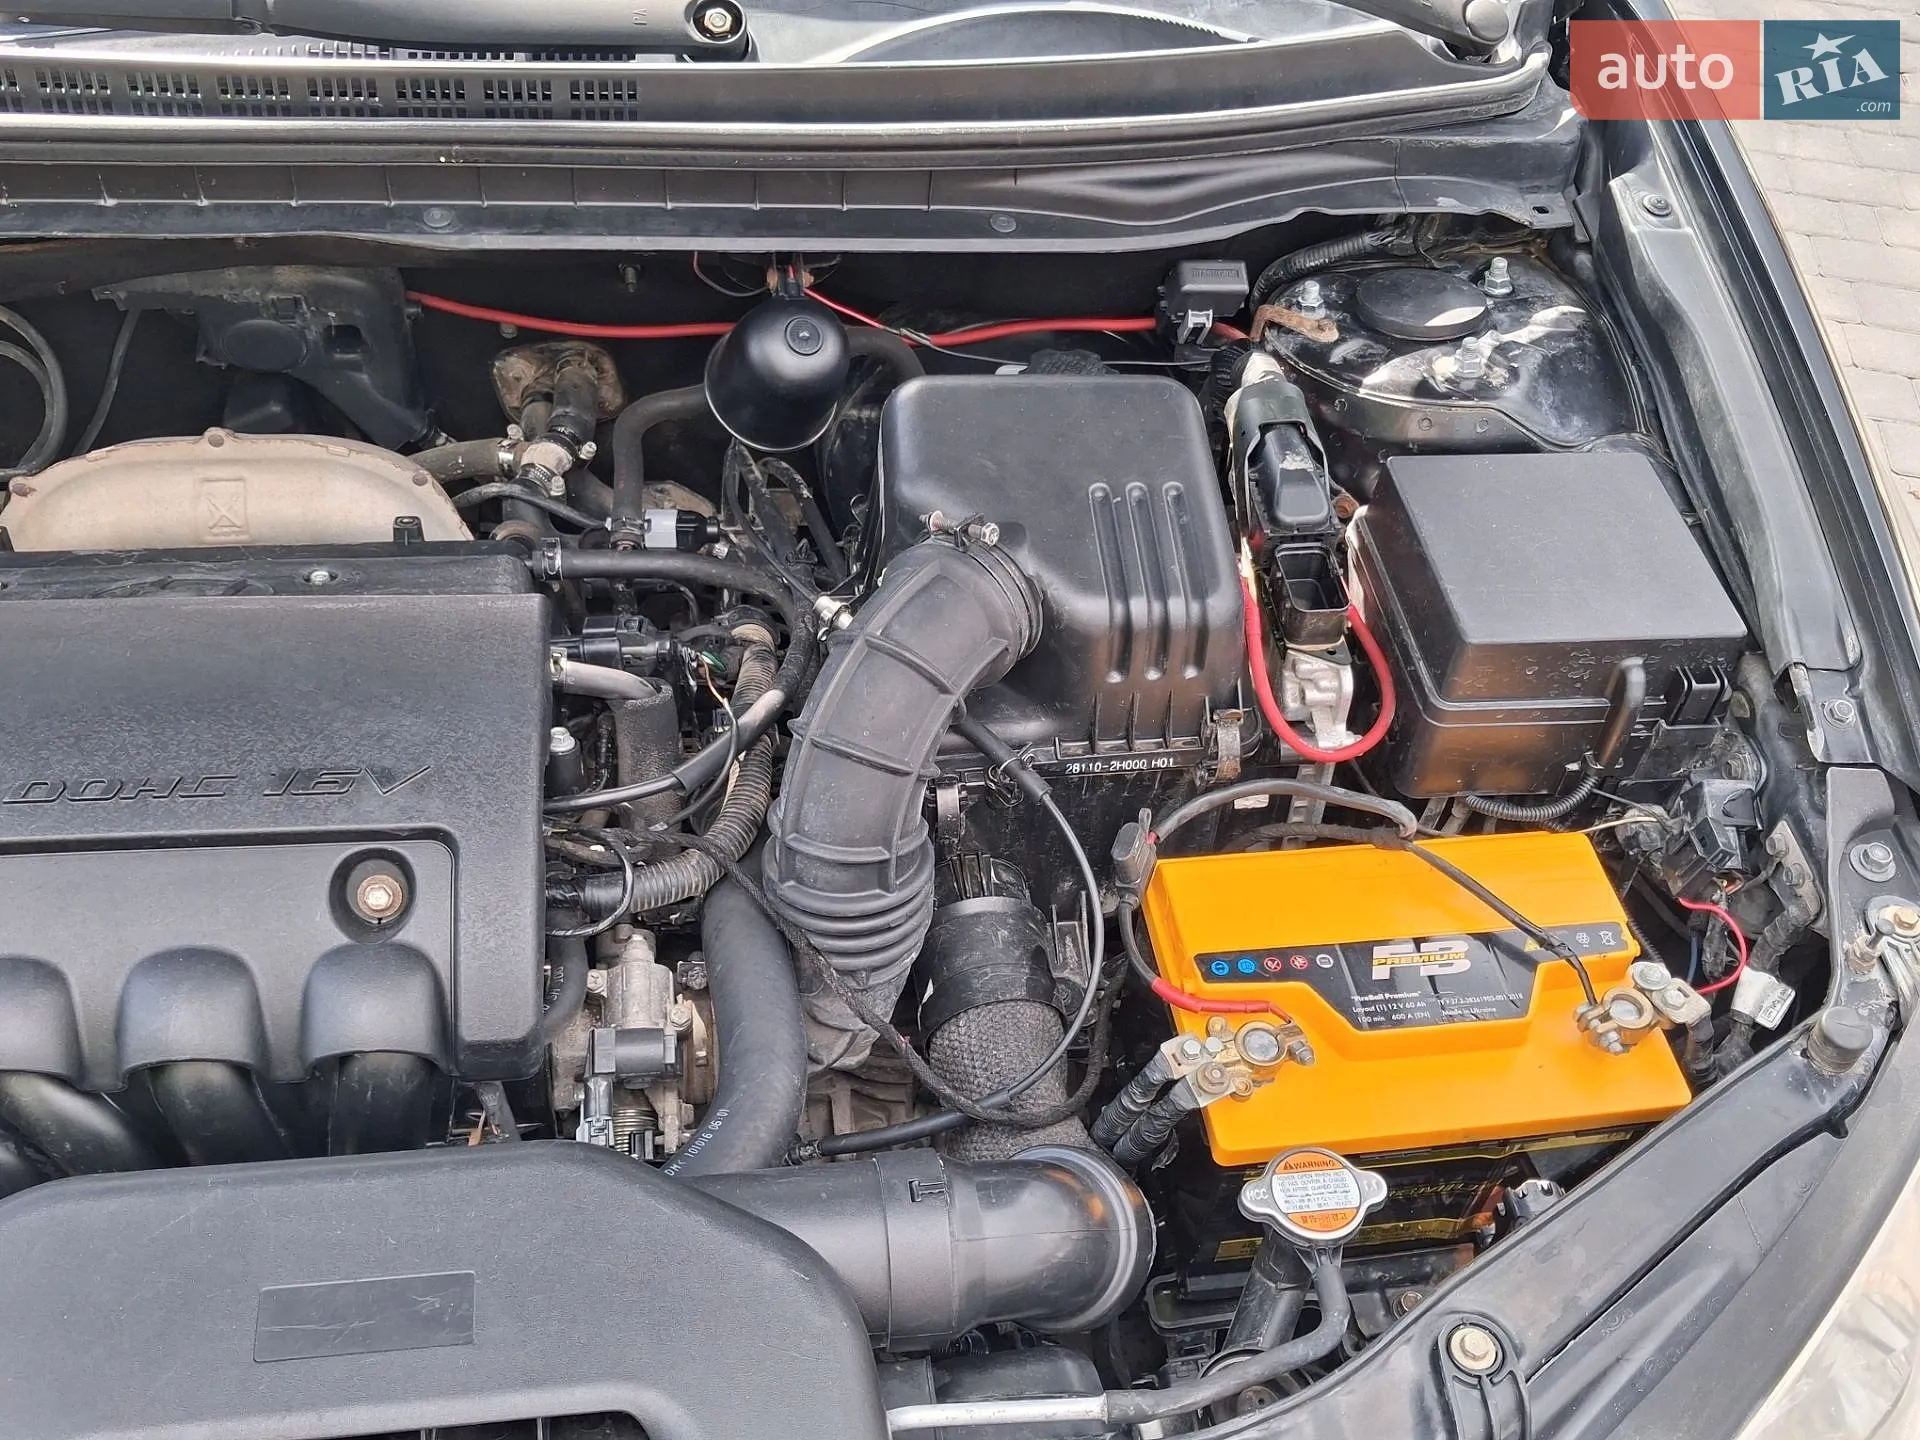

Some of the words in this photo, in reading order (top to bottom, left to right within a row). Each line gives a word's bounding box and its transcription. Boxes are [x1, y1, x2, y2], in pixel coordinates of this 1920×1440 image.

[1065, 760, 1147, 775] 28110-2H000
[1151, 758, 1175, 768] H01
[2, 774, 239, 803] DOHC
[262, 764, 431, 796] 16V
[1372, 940, 1471, 980] FB
[1373, 952, 1466, 966] PREMIUM
[684, 1132, 713, 1158] 101016
[1293, 1159, 1336, 1170] WARNING
